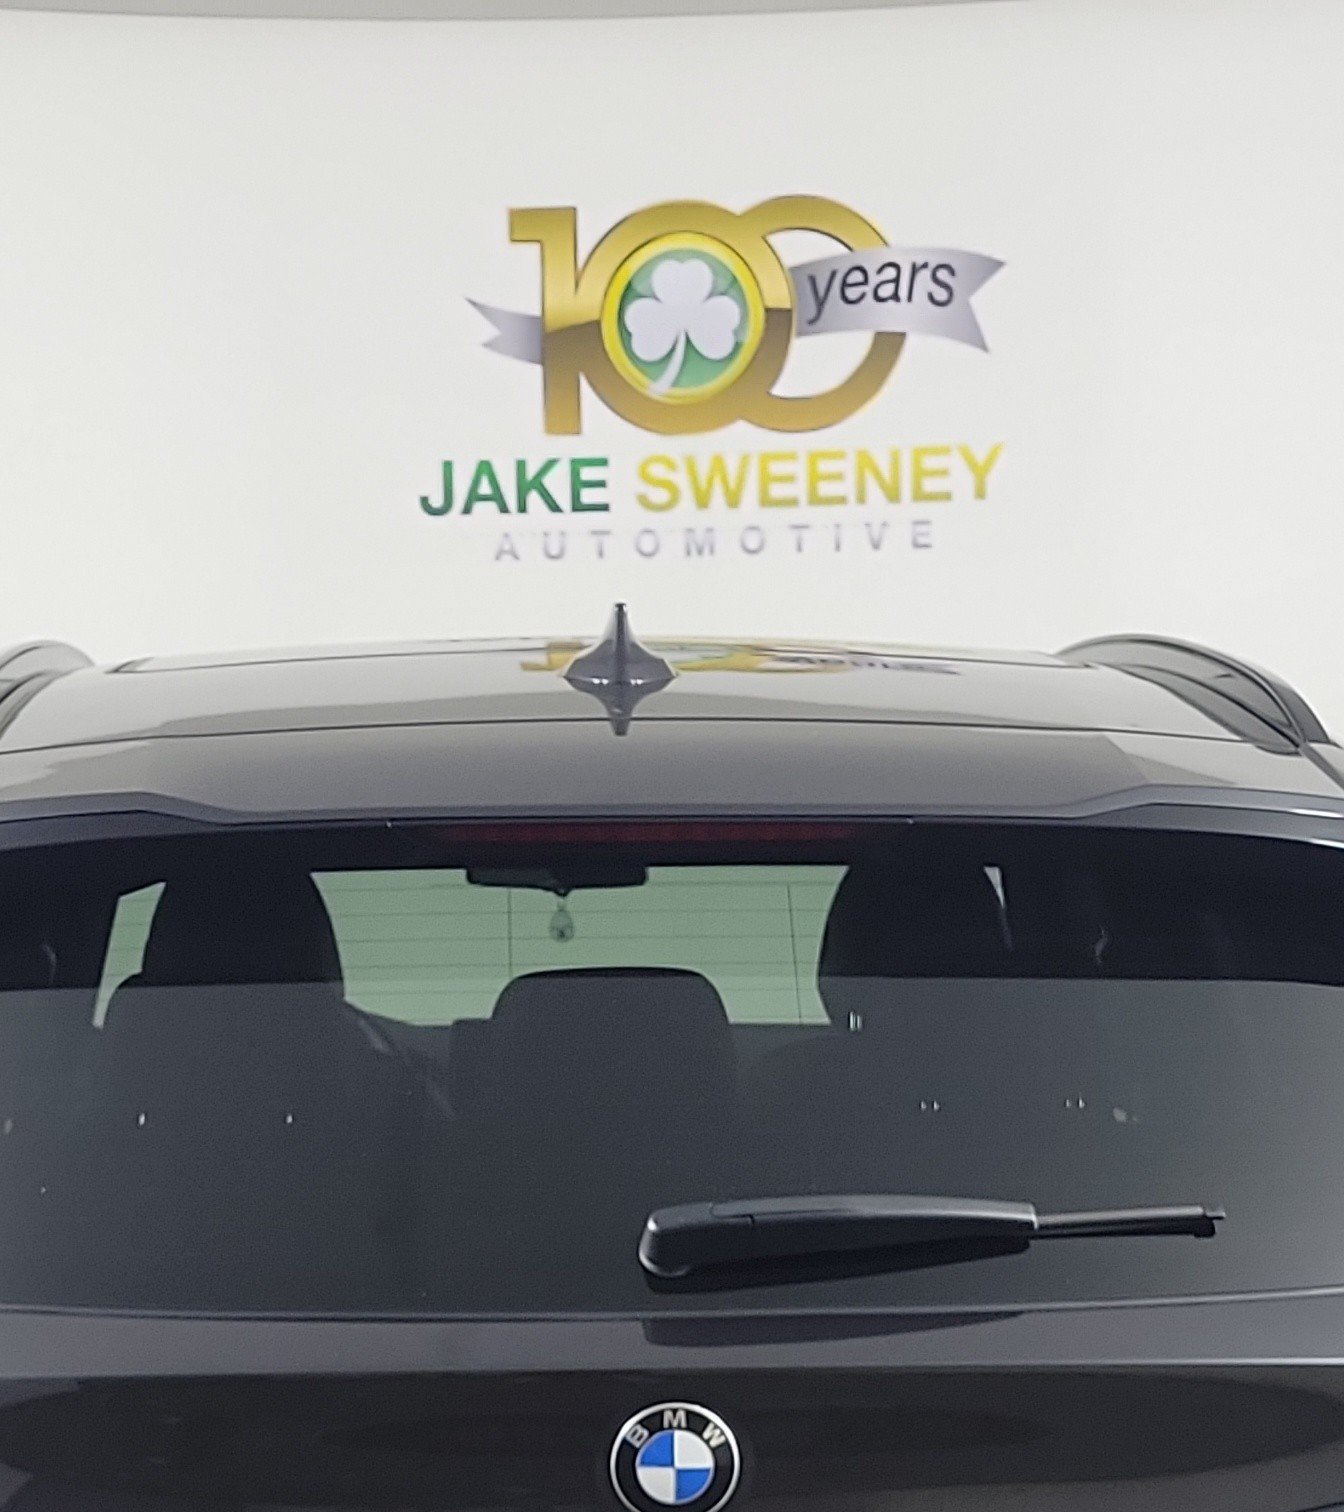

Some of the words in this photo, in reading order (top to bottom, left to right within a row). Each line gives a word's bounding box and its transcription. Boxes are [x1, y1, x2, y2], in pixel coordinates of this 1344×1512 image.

[509, 194, 907, 435] 100
[808, 261, 957, 325] years
[419, 456, 611, 516] JAKE
[635, 442, 1004, 511] SWEENEY
[494, 519, 934, 562] AUTOMOTIVE
[625, 1410, 726, 1448] BMW
